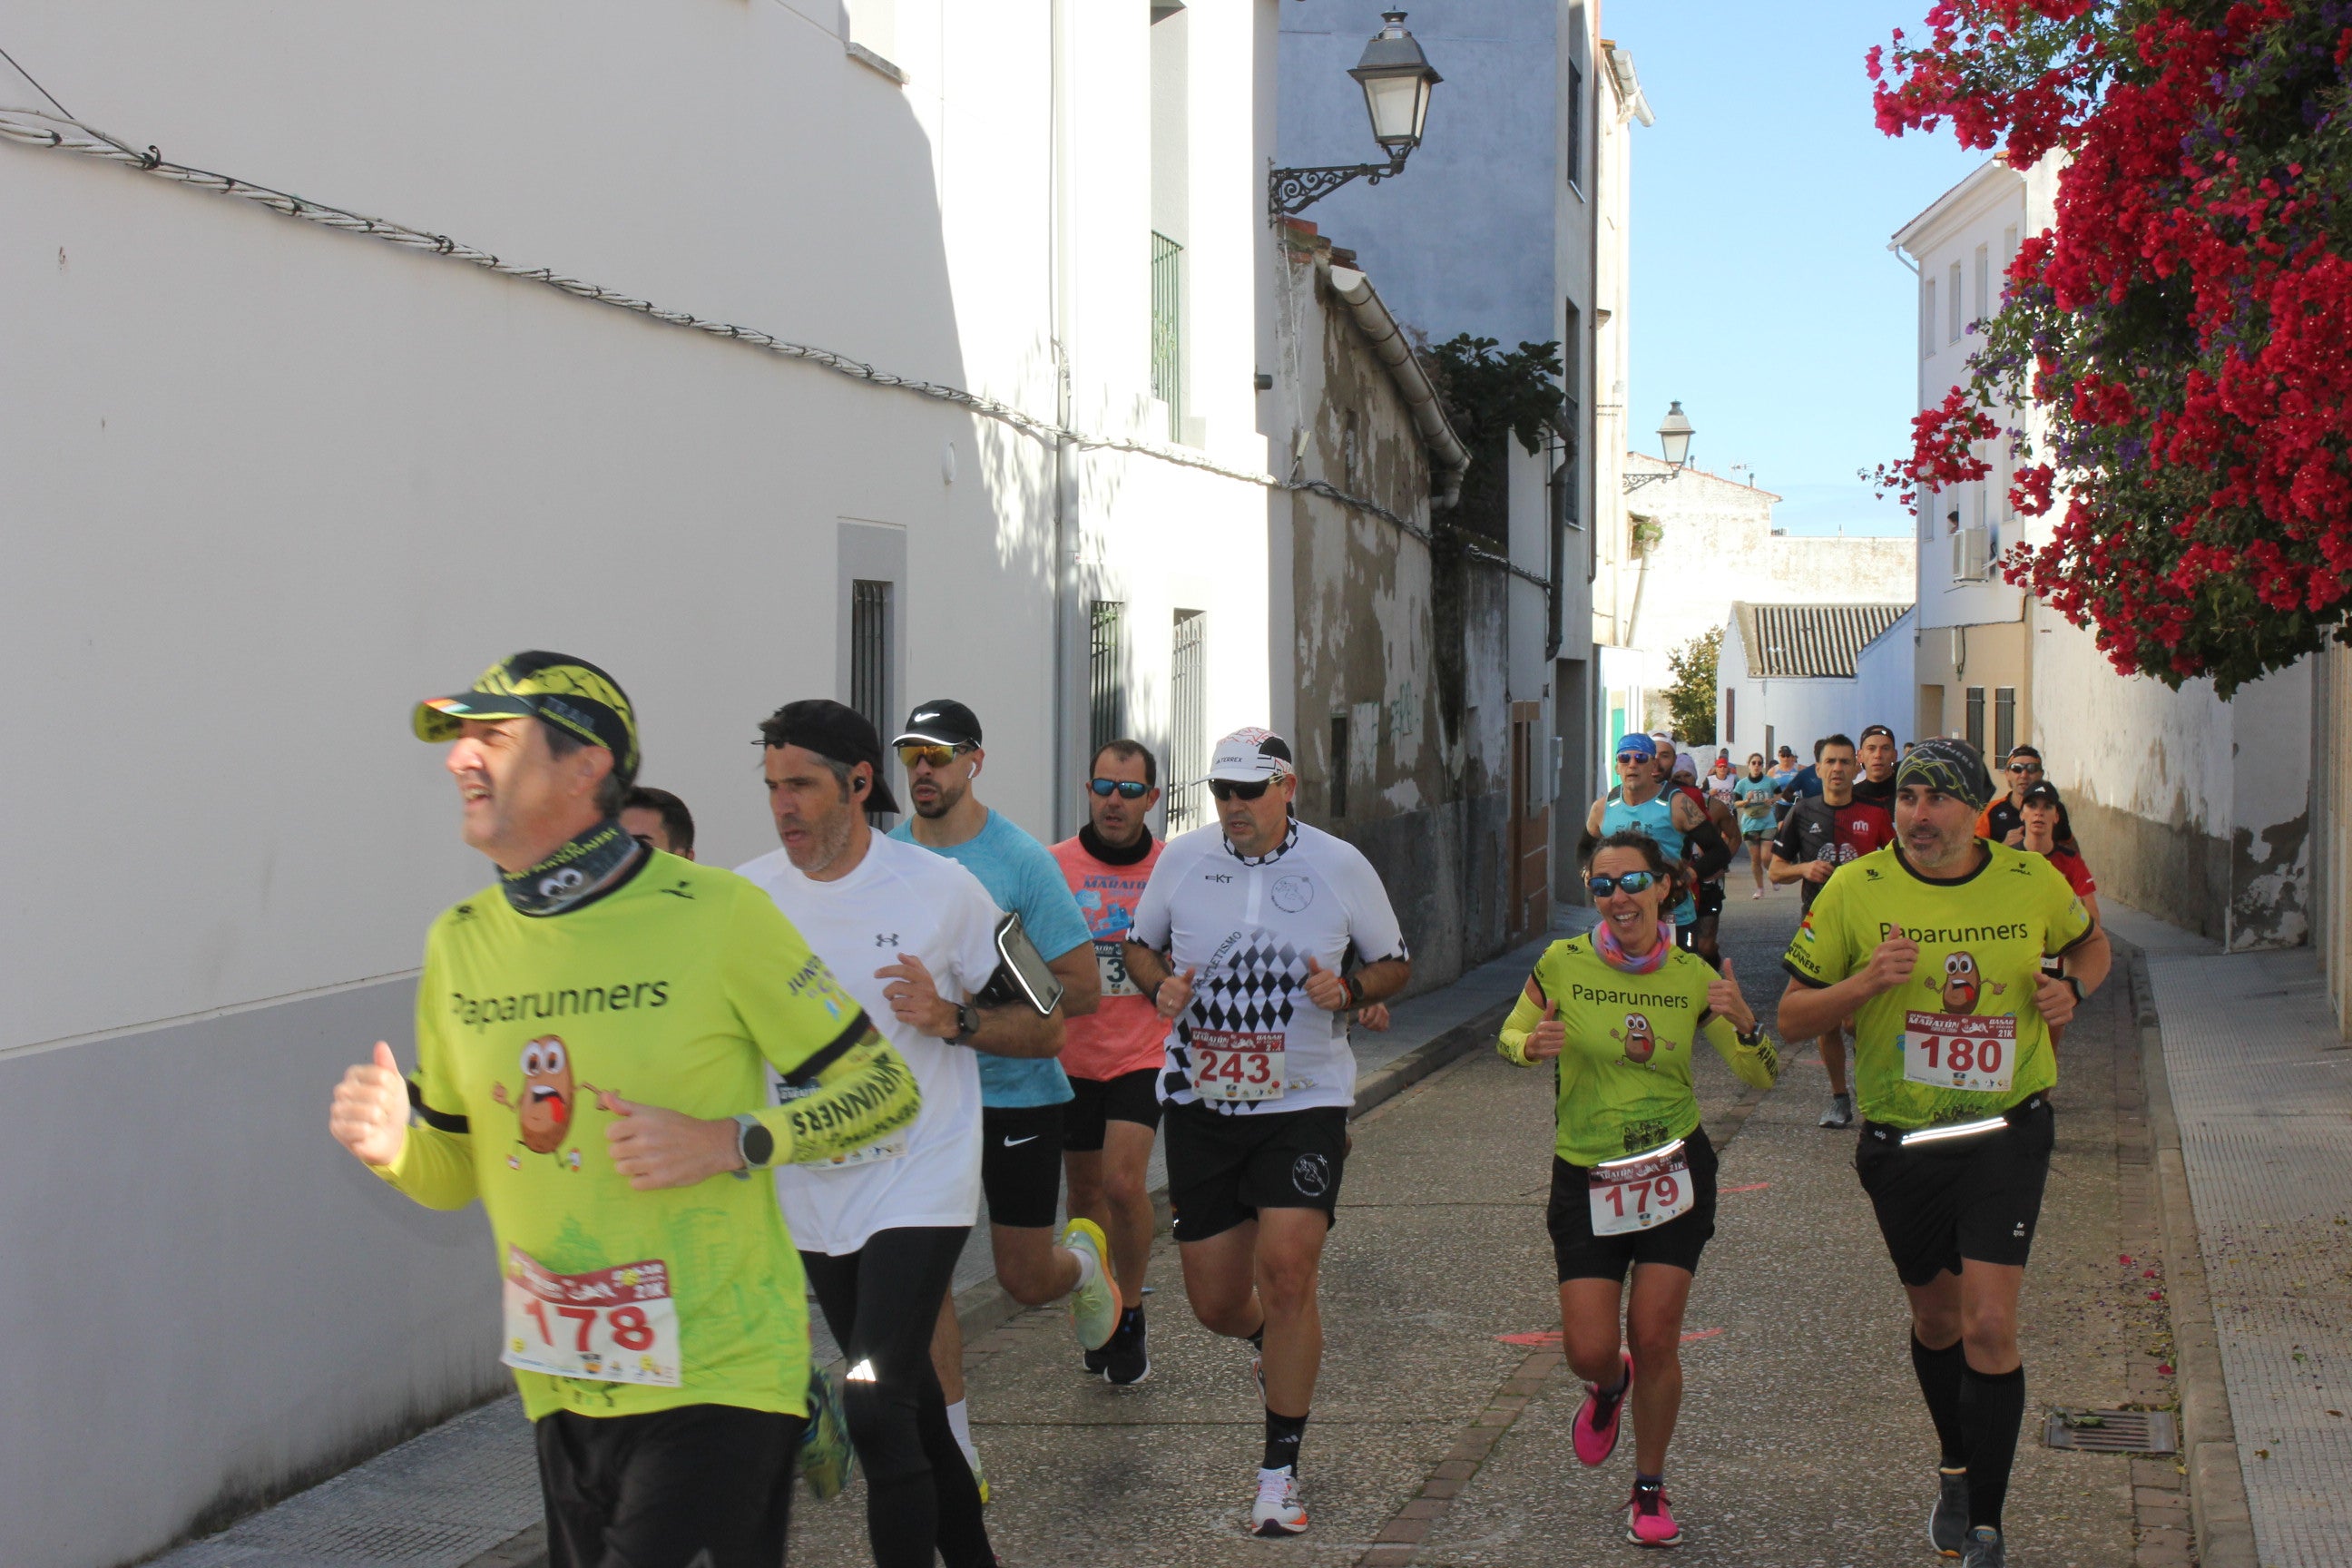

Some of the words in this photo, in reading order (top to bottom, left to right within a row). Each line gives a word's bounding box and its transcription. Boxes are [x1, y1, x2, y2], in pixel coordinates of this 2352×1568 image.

[1572, 984, 1689, 1009] Paparunners
[1998, 1029, 2014, 1038] 21K
[1200, 1050, 1270, 1084] 243
[1920, 1035, 2002, 1073] 180
[1605, 1175, 1679, 1218] 179
[524, 1299, 655, 1351] 178
